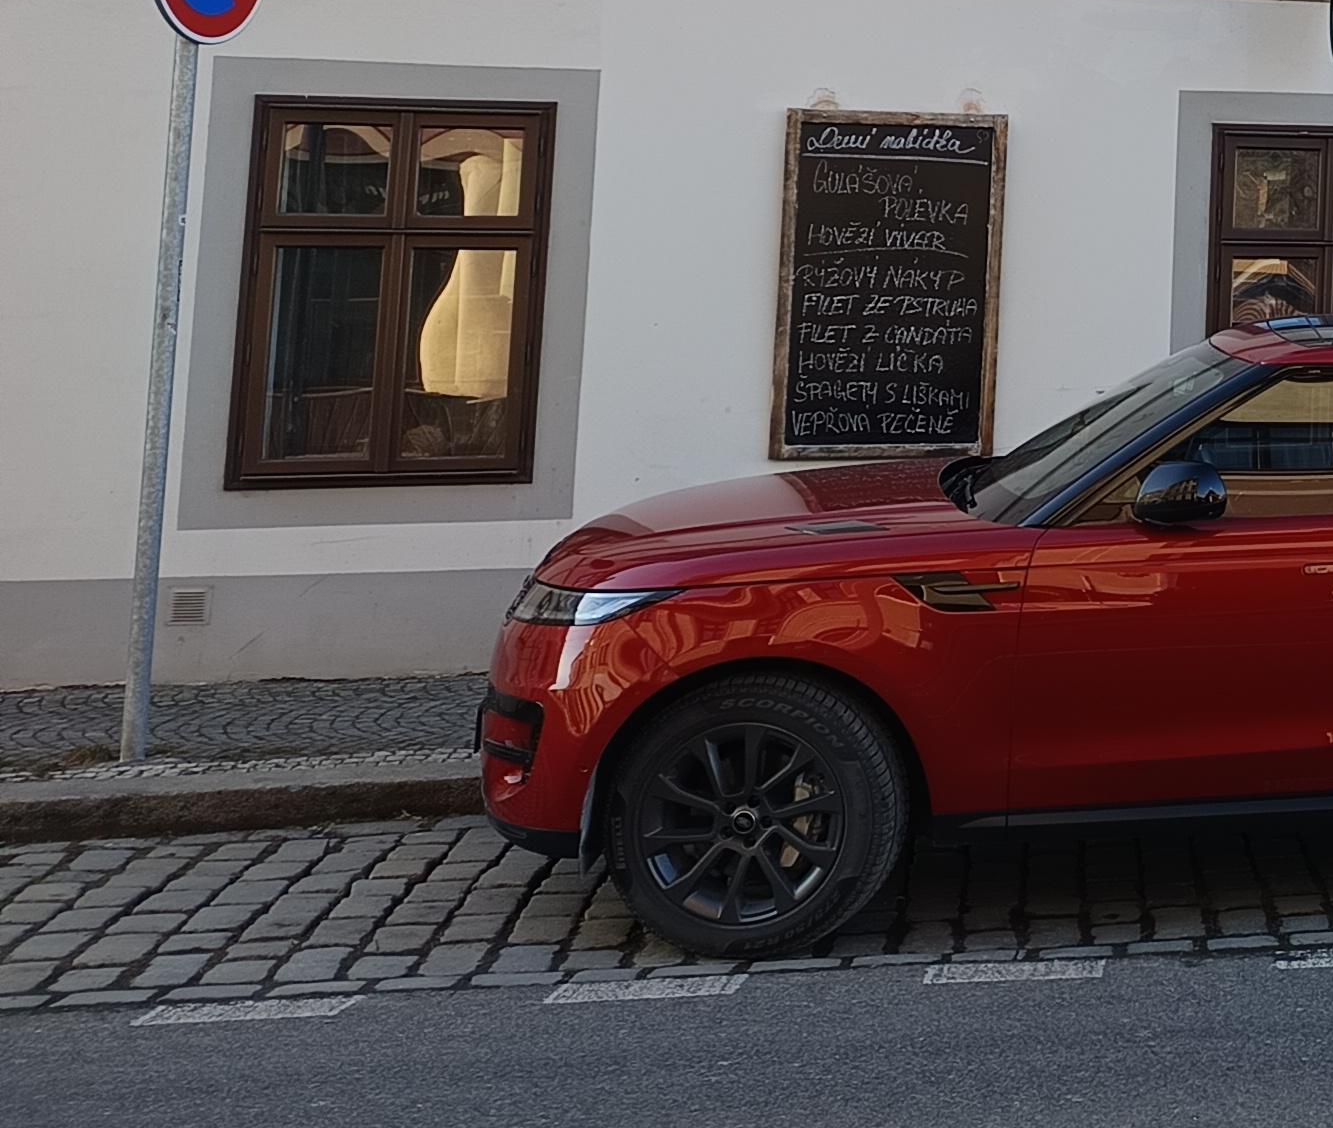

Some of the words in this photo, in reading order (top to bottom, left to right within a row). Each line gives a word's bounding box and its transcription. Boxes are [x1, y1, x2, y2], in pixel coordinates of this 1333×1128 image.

[802, 293, 861, 316] FILET
[862, 294, 893, 315] ZE
[798, 322, 857, 344] FILET
[861, 325, 880, 344] Z
[884, 382, 898, 404] S
[719, 697, 845, 749] SCORPION
